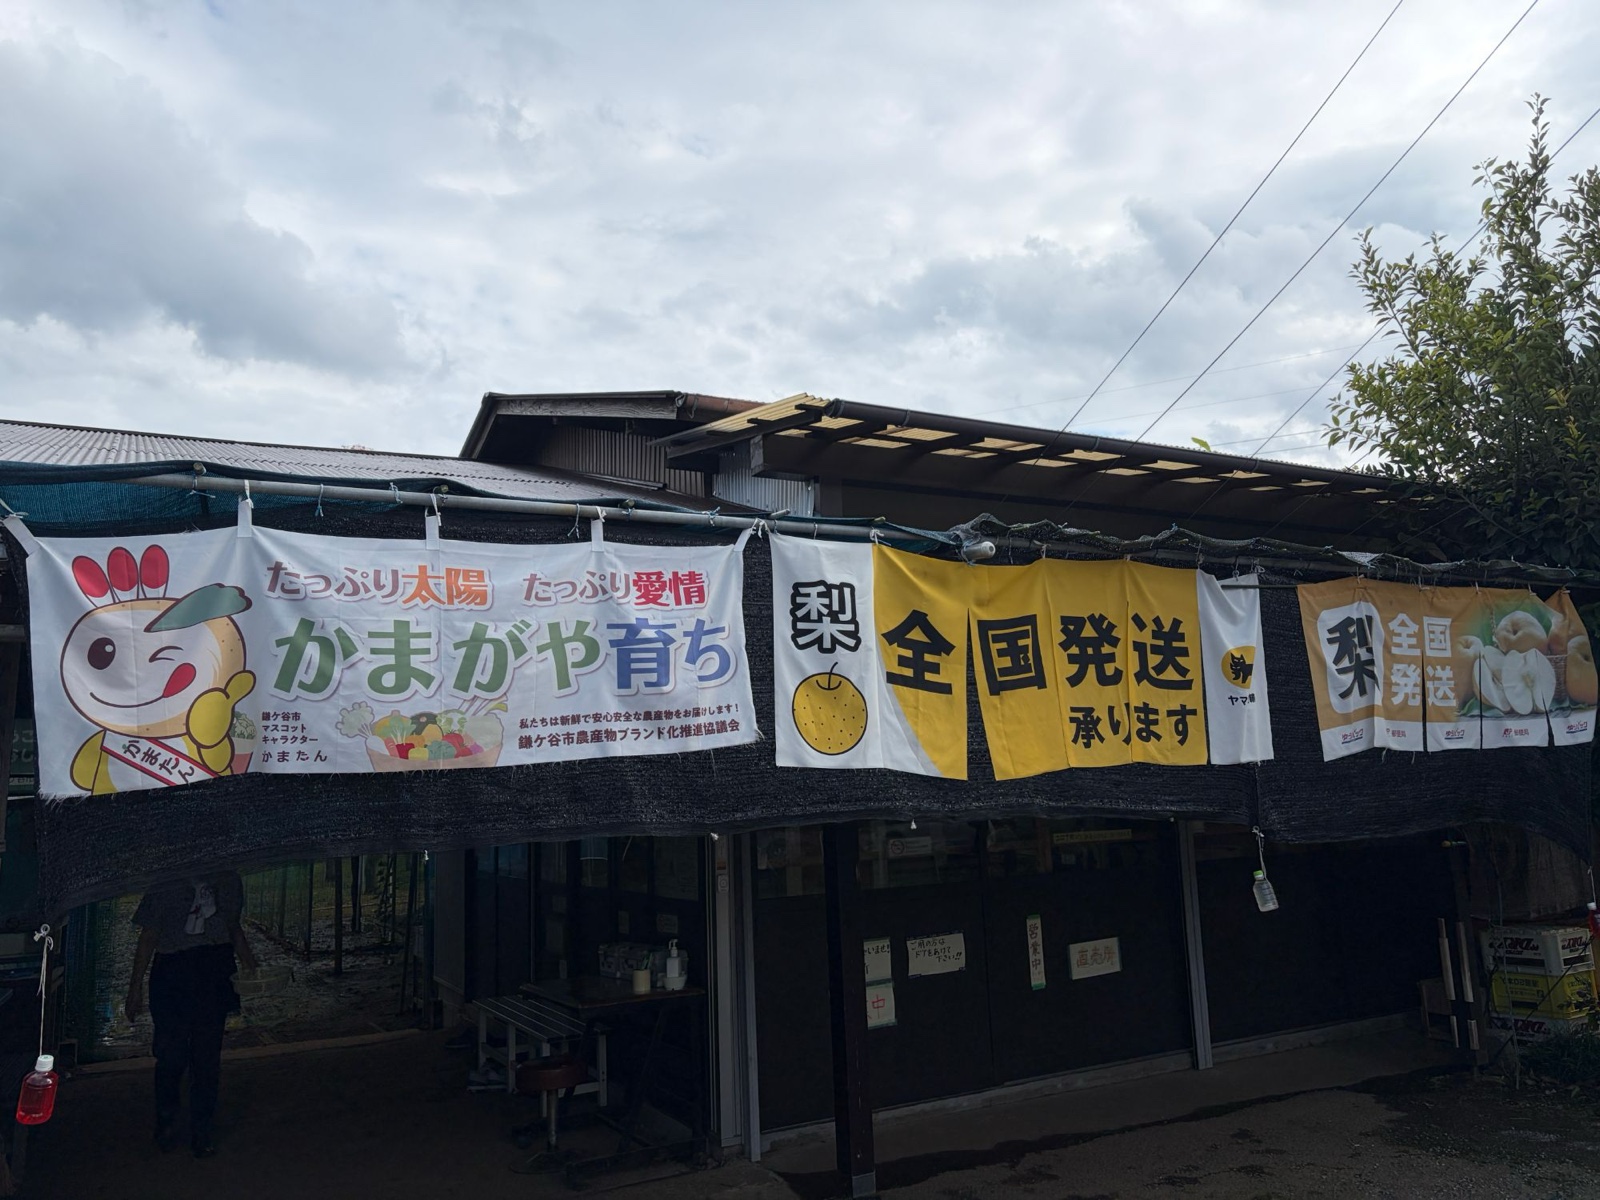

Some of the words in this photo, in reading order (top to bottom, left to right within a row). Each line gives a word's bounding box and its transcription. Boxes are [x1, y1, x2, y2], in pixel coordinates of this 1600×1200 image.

[266, 560, 489, 607] たっぷり太陽
[522, 570, 706, 607] たっぷり愛情
[790, 579, 862, 653] 梨
[1387, 612, 1452, 658] 全国
[272, 616, 731, 695] かまがや育ち
[881, 609, 1195, 697] 全国発送
[1326, 614, 1380, 700] 梨
[1390, 663, 1457, 707] 発送
[261, 723, 307, 734] マスコット
[261, 734, 319, 745] キャラクター
[1069, 701, 1198, 749] 承ります
[122, 740, 196, 783] かまたん
[261, 749, 328, 763] かまたん
[1028, 922, 1042, 971] 営業中
